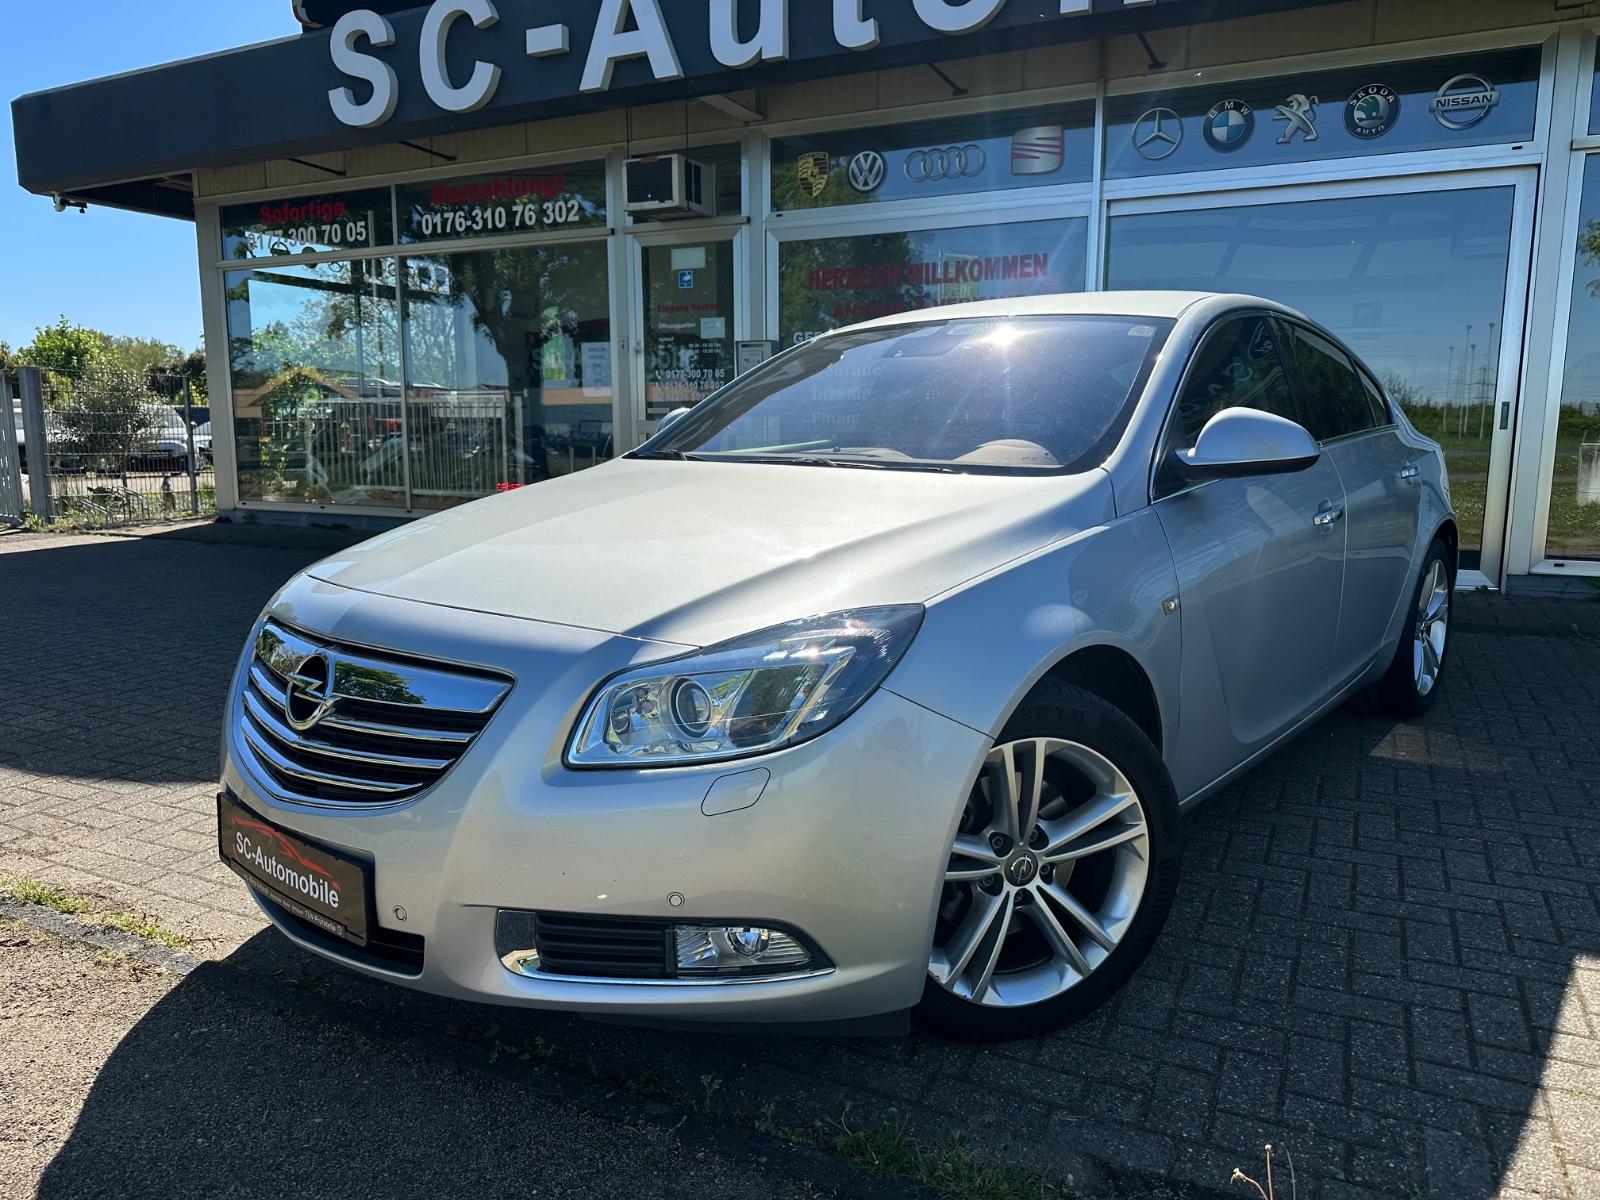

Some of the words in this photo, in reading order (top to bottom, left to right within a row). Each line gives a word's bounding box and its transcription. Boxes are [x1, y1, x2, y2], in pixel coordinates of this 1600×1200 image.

[1208, 101, 1251, 118] BMW
[1435, 93, 1493, 108] NISSAN
[1355, 125, 1385, 135] AUTO
[259, 200, 347, 225] Sofortige
[421, 206, 506, 236] 0176-310
[512, 203, 537, 227] 76
[542, 200, 580, 225] 302
[321, 223, 342, 245] 70
[346, 221, 367, 243] 05
[808, 264, 901, 290] HERZLICH
[905, 252, 1049, 286] WILLKOMMEN
[236, 831, 340, 909] SC-Automobile
